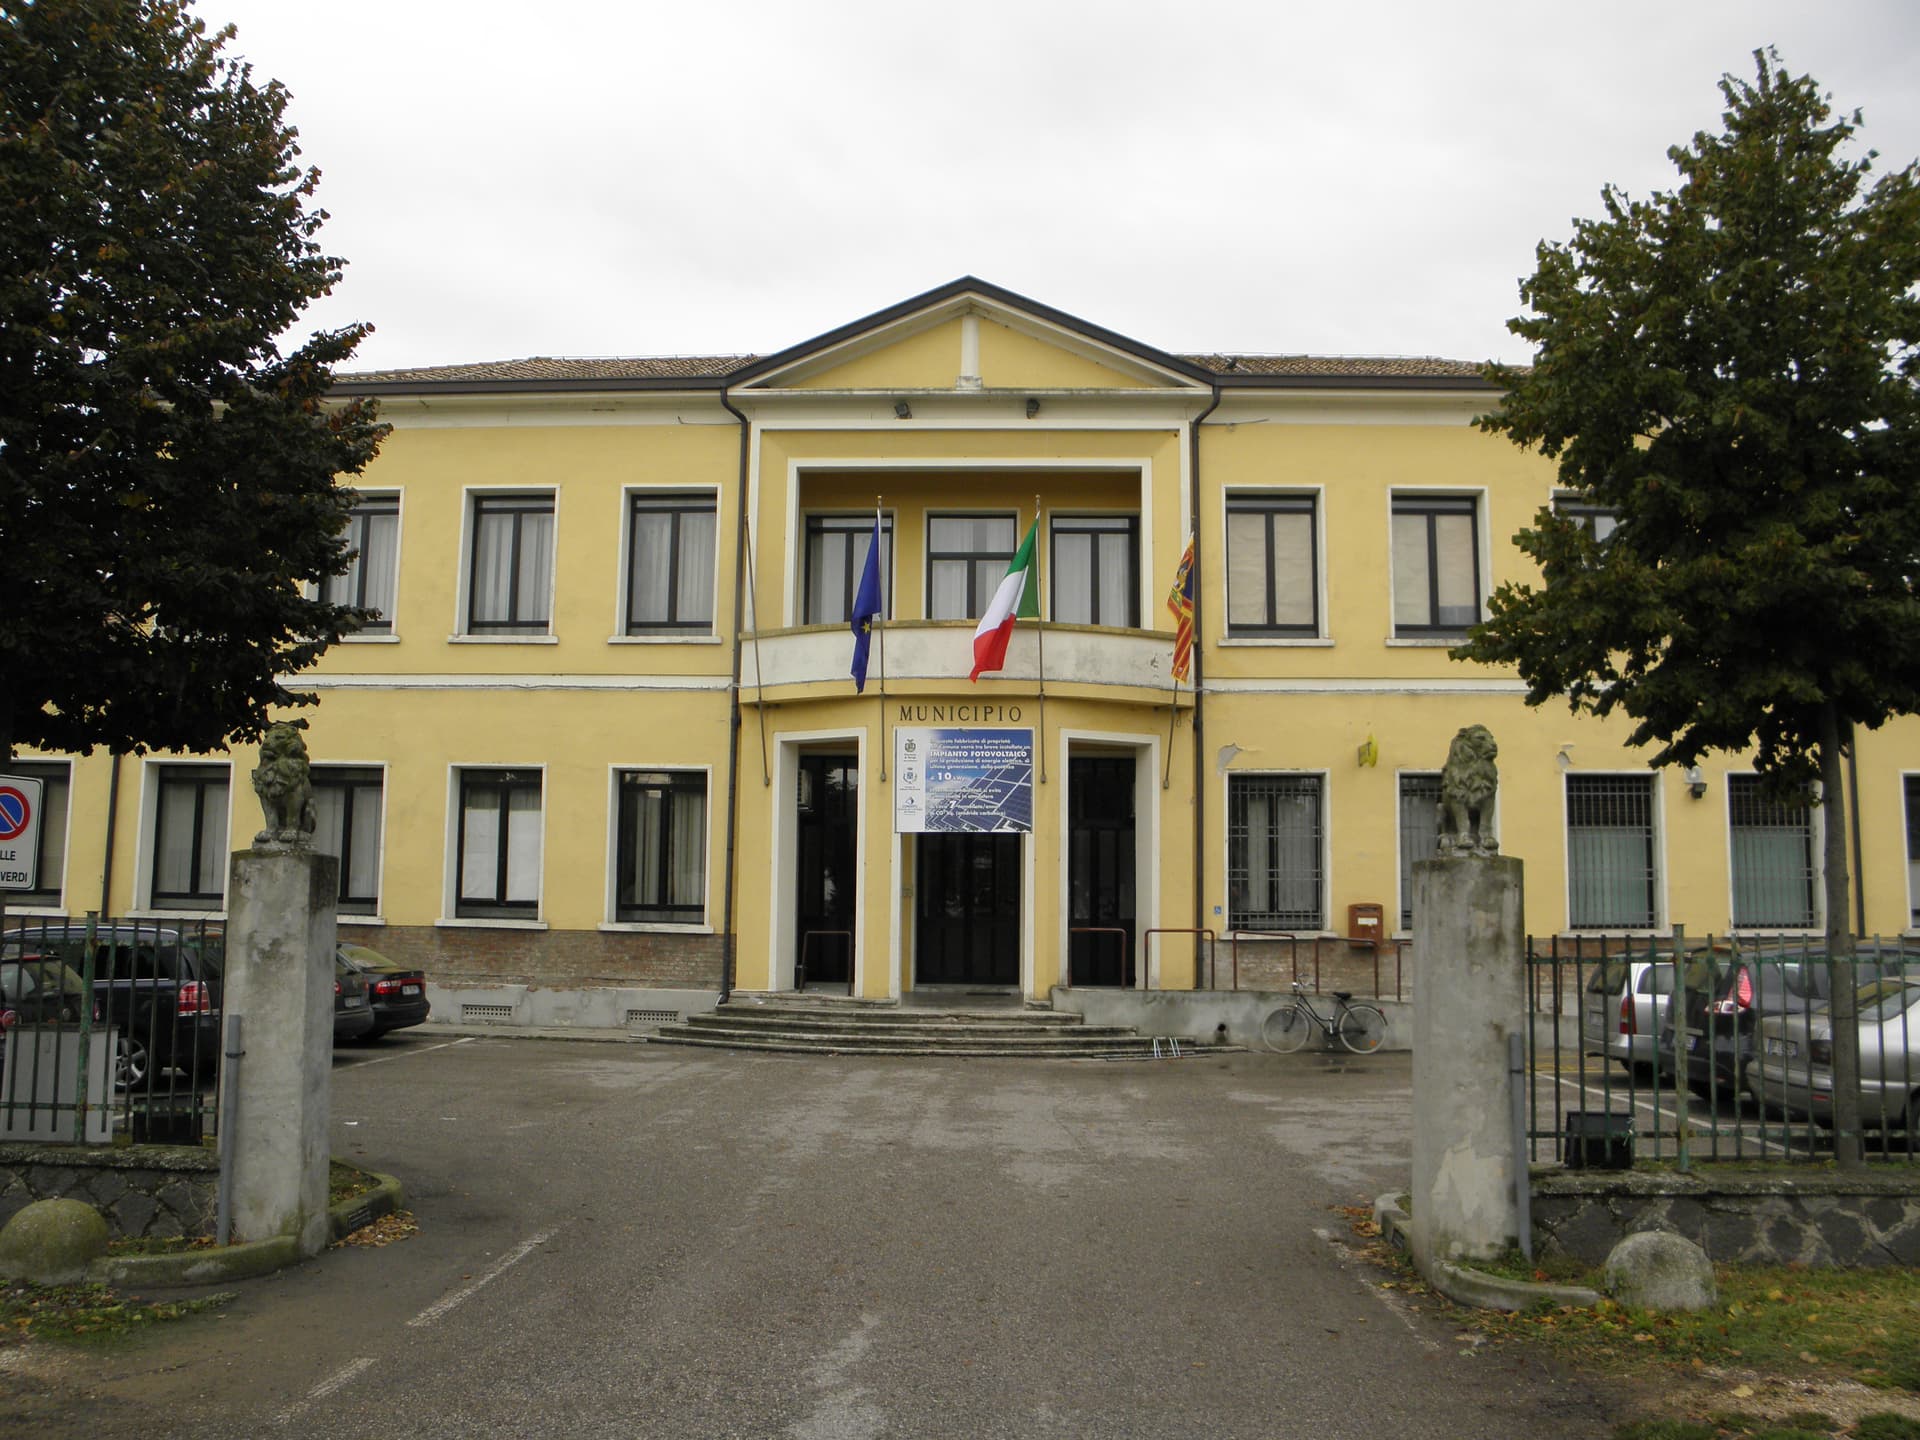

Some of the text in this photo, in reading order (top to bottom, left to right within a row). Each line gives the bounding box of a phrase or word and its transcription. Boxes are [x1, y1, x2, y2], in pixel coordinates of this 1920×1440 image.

[900, 705, 1022, 722] MUNICIPIO
[930, 750, 1028, 758] IMPIANTO FOTOVOLTAICO
[937, 772, 952, 781] 10
[0, 871, 28, 883] VERDI
